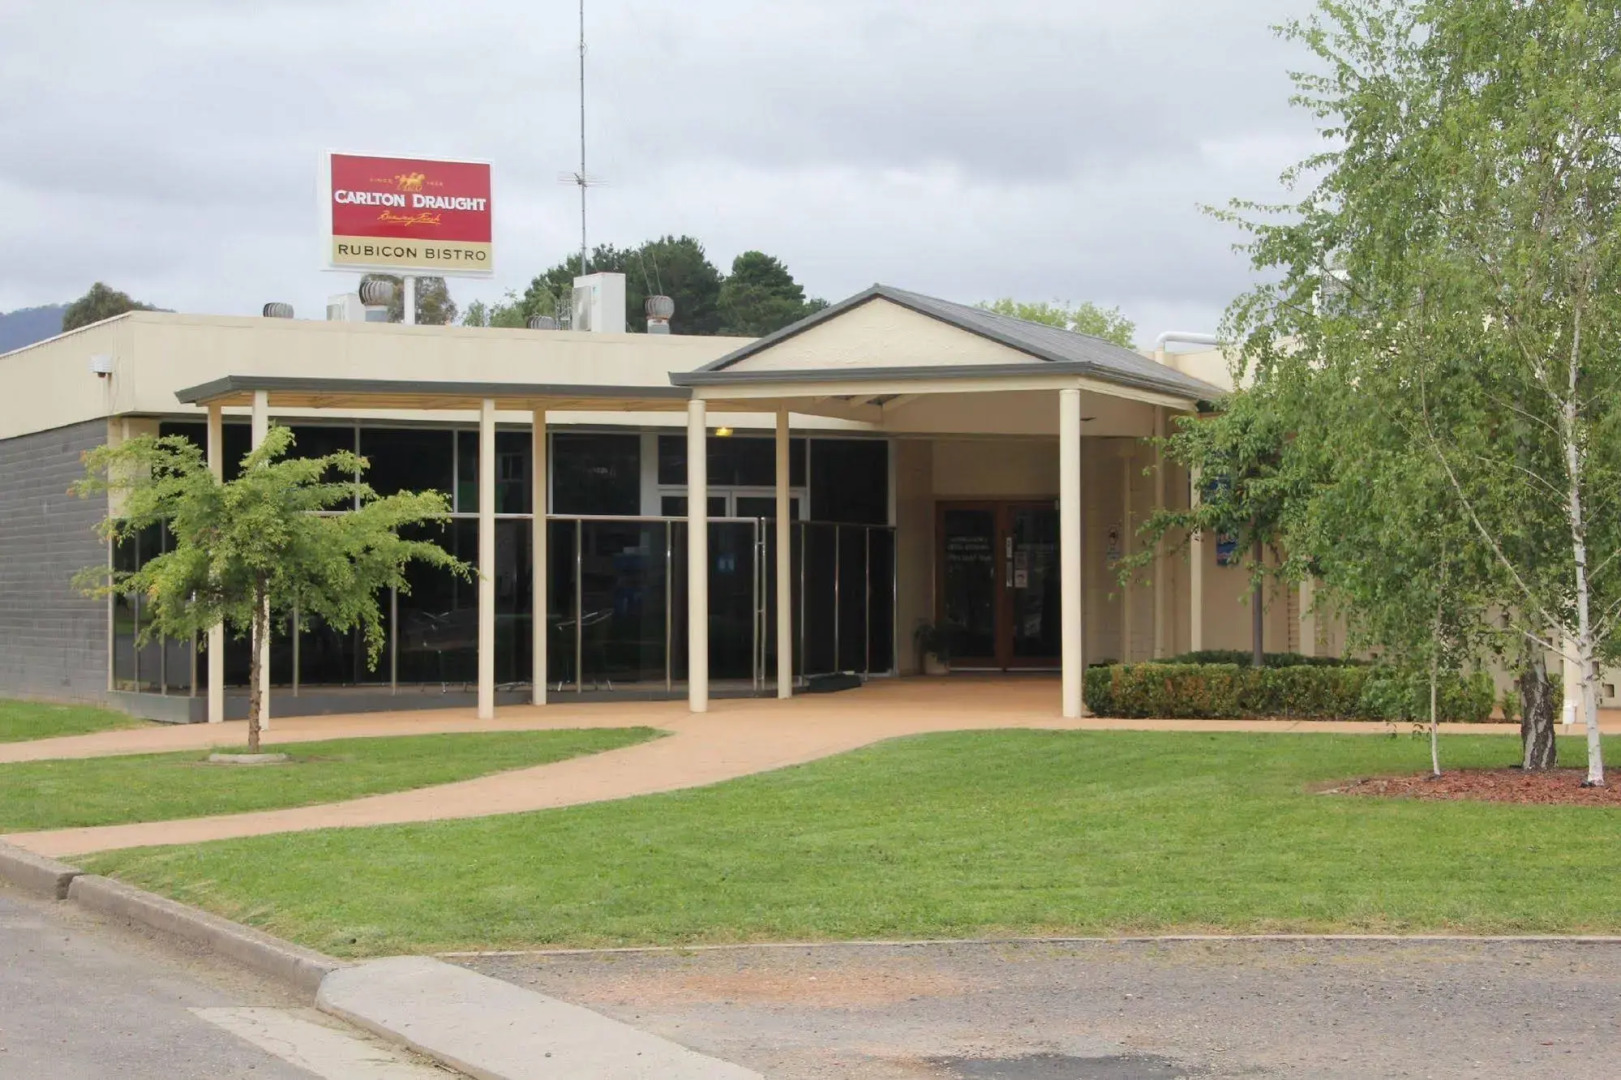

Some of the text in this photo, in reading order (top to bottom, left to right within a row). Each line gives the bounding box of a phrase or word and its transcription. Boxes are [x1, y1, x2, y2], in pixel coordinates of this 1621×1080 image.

[334, 190, 486, 211] CARLTON DRAUGHT
[338, 244, 486, 261] RUBICON BISTRO
